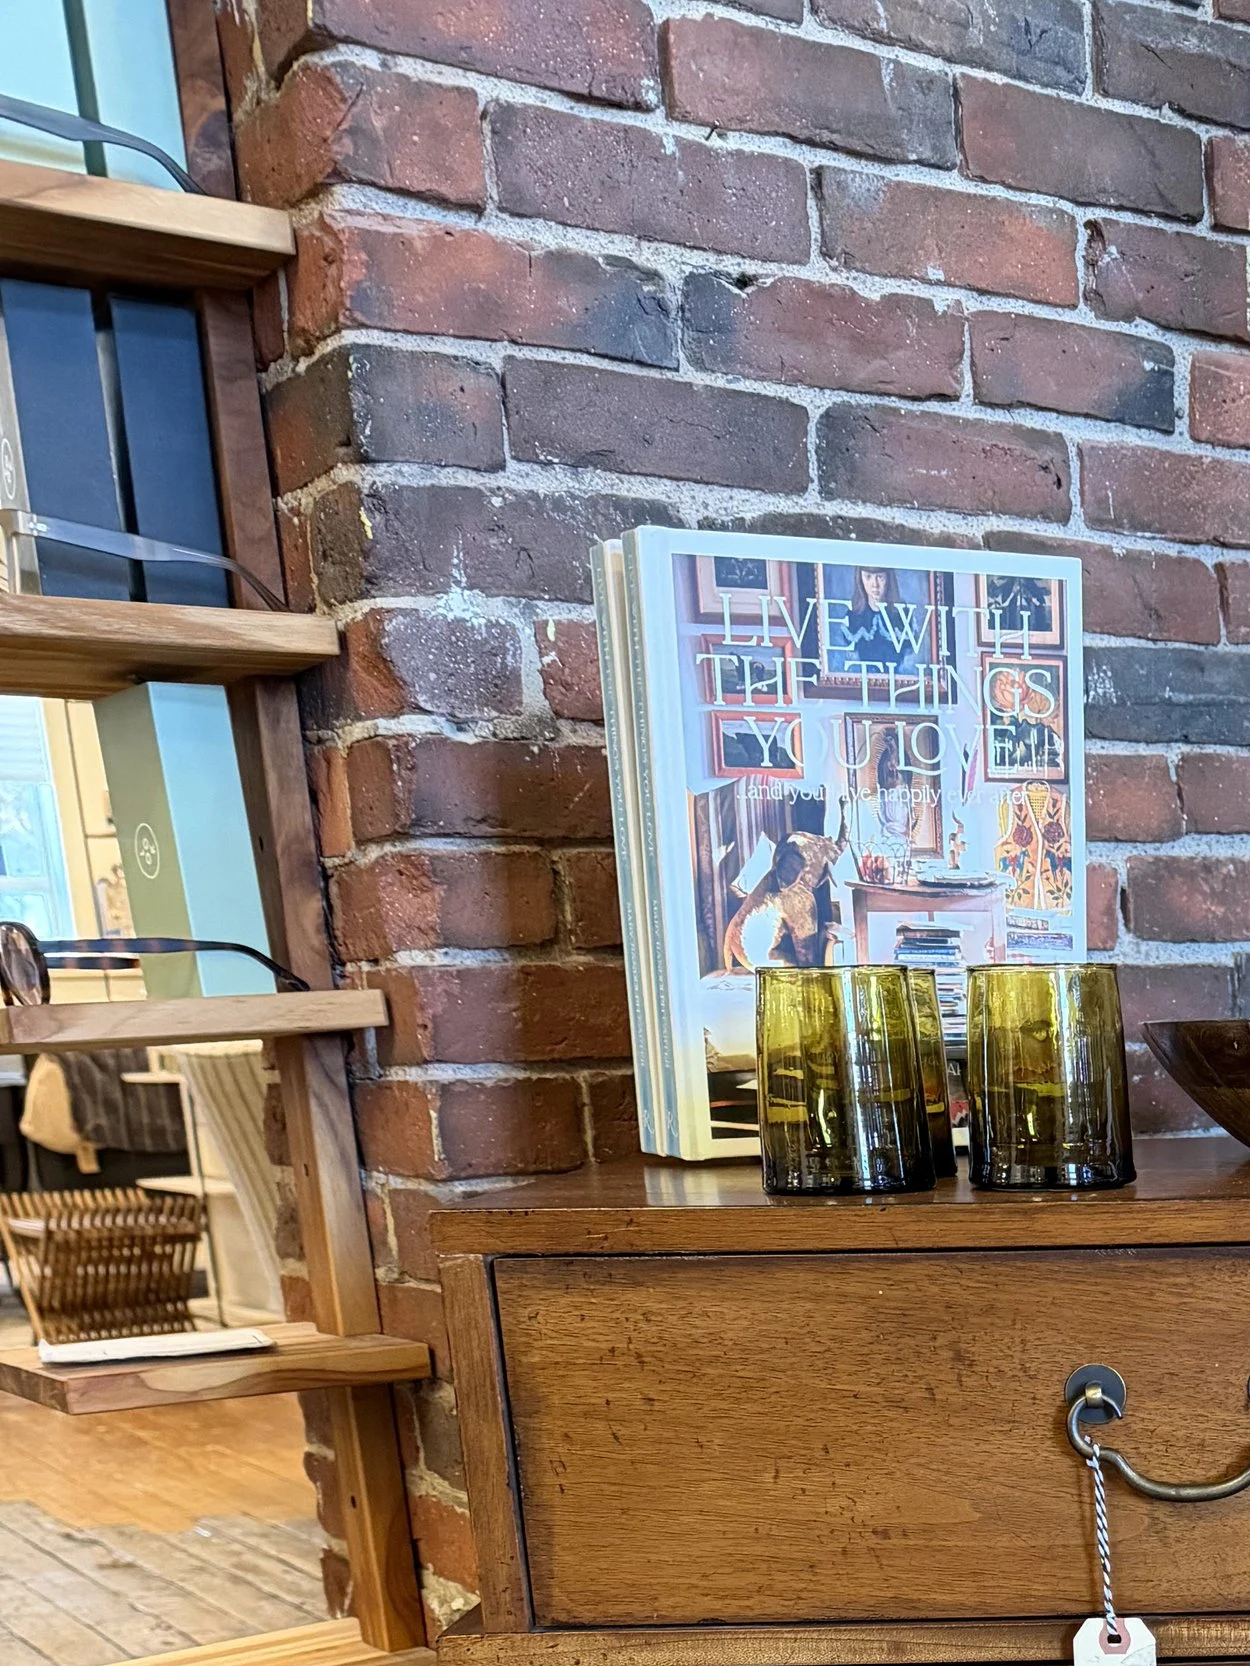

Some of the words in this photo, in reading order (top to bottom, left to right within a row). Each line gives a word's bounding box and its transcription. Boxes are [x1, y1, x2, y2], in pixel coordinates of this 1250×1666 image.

[718, 593, 855, 652] LIVE
[877, 602, 1034, 660] WITH
[696, 654, 822, 707] THE
[845, 660, 1055, 718] THINGS
[744, 716, 872, 769] YOU
[895, 720, 1019, 776] LOVE
[877, 782, 941, 806] happily
